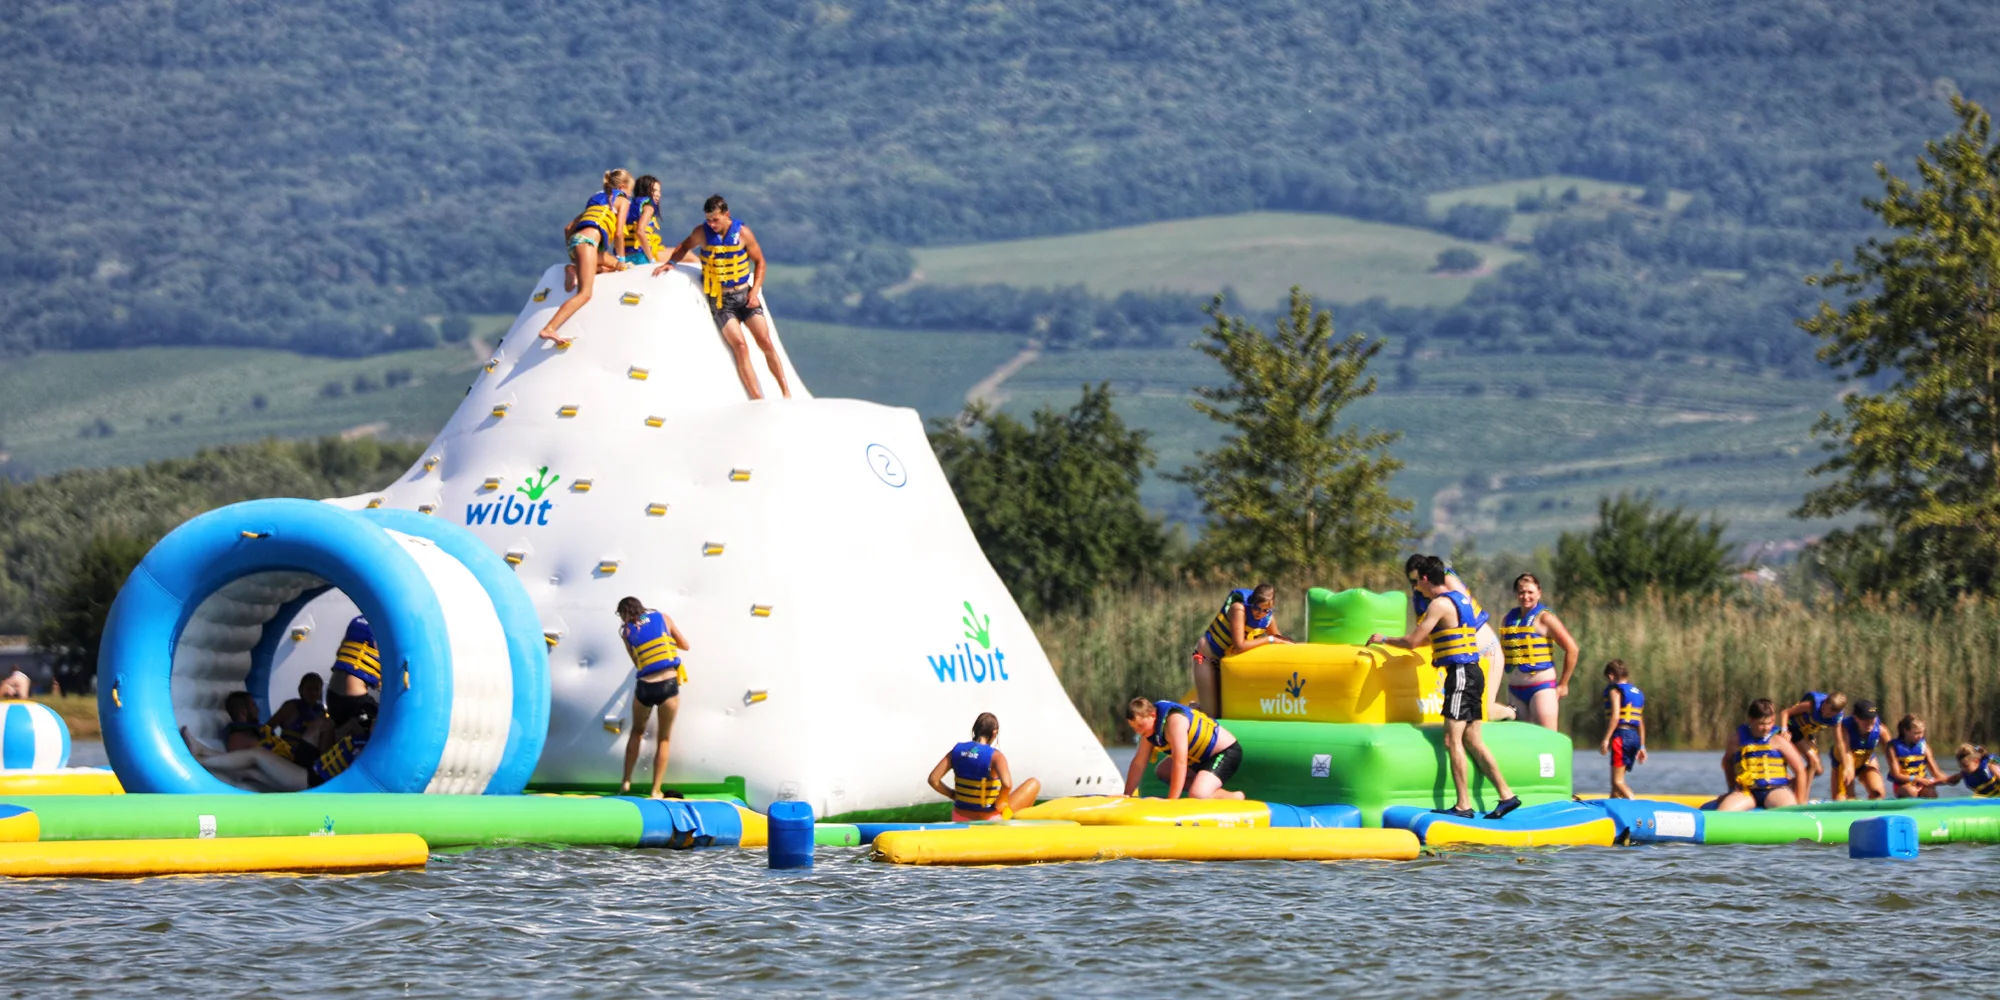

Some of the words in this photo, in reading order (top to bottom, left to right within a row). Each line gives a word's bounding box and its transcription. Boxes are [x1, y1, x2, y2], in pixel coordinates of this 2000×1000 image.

[878, 454, 897, 475] 2
[466, 494, 553, 526] wibit
[927, 642, 1008, 683] wibit
[1260, 693, 1307, 715] wibit
[1416, 693, 1444, 715] wib
